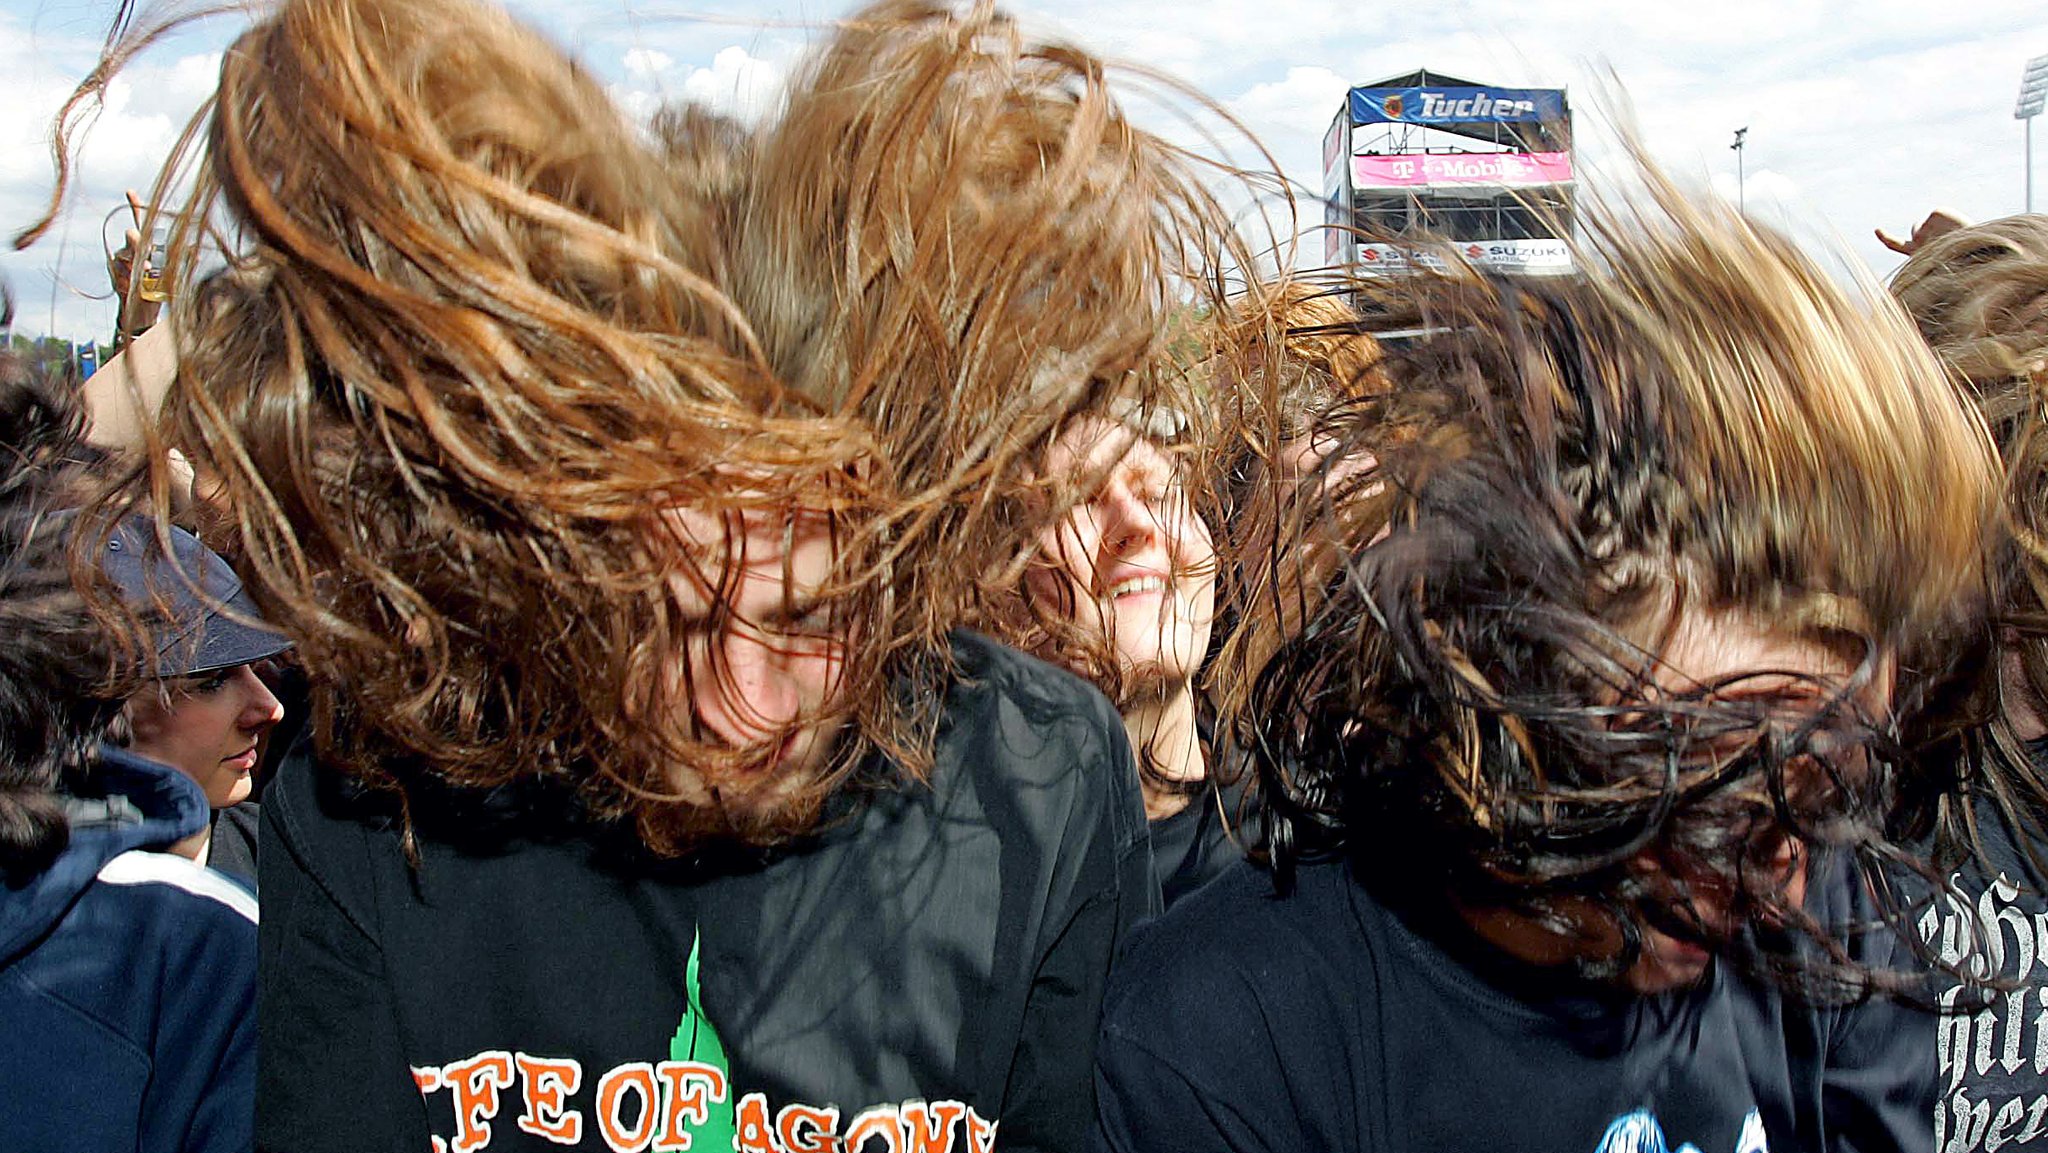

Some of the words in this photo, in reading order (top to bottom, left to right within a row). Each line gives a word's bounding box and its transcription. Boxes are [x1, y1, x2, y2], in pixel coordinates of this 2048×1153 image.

[1420, 92, 1534, 118] Tucher
[1489, 246, 1567, 258] SUZUKI
[596, 1061, 727, 1153] OF
